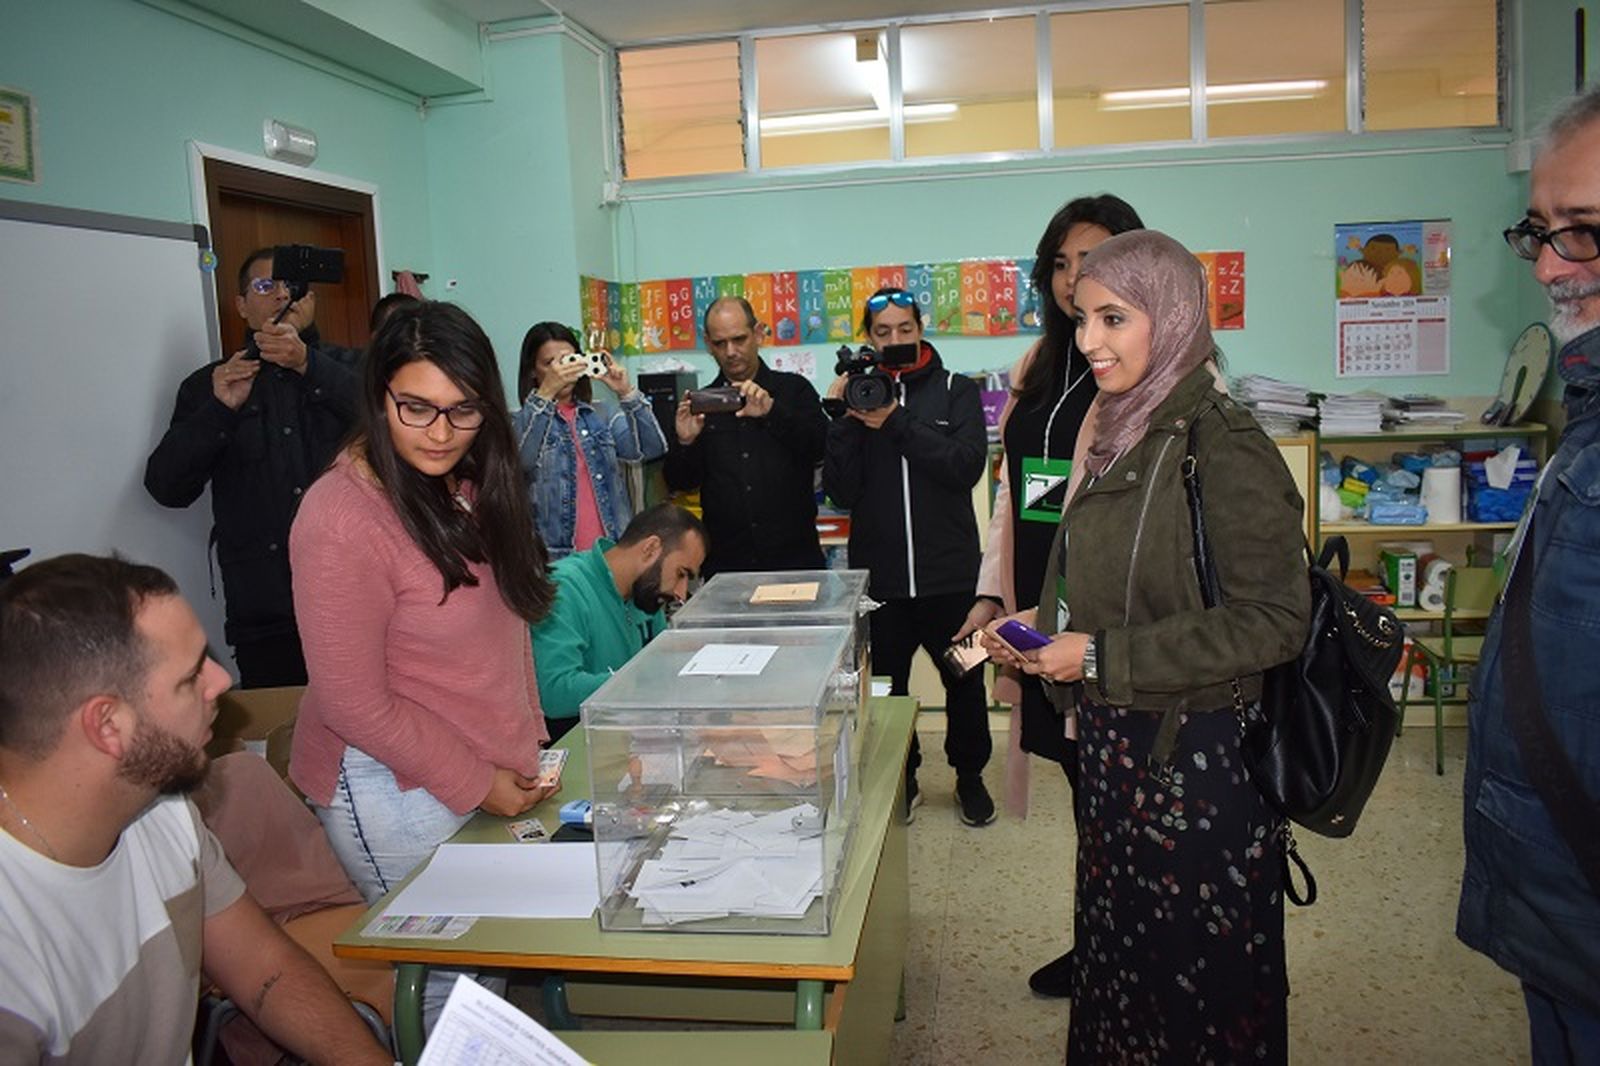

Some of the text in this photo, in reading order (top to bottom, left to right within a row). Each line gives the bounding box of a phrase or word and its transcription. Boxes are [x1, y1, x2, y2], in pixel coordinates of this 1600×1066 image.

[680, 287, 690, 301] G
[1230, 280, 1240, 294] Z
[680, 304, 692, 319] G
